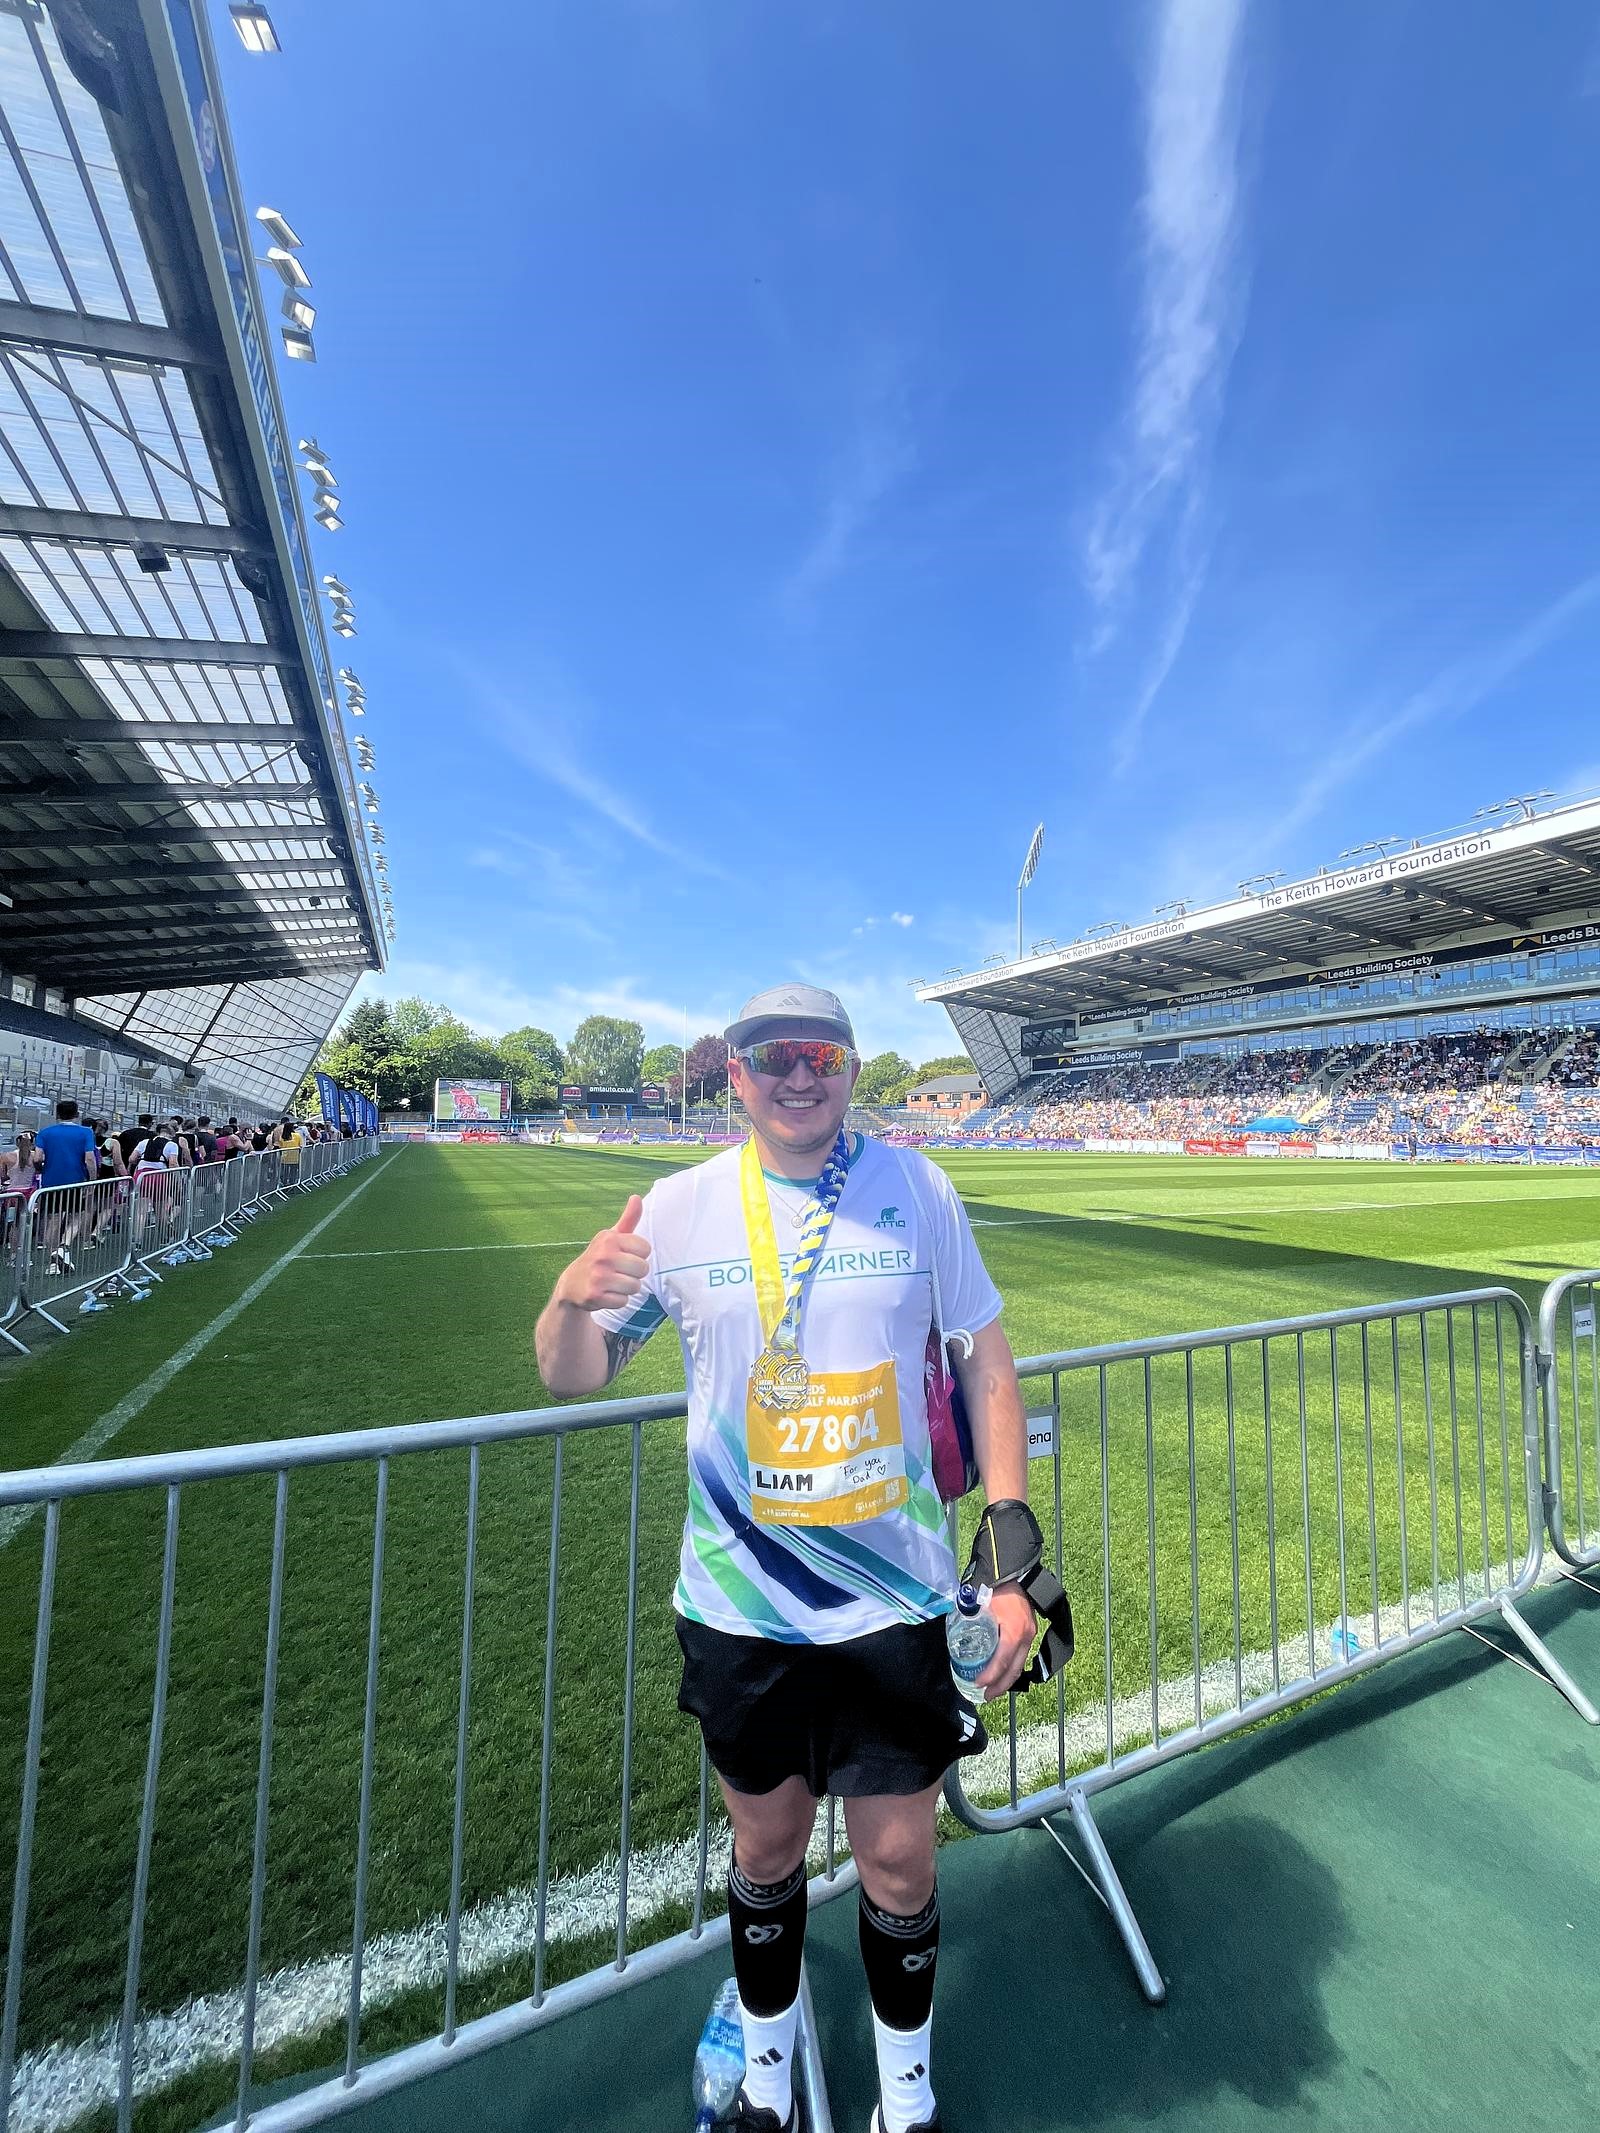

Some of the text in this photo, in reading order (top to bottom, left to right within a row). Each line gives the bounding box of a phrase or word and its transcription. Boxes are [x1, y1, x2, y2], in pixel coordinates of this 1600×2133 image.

[1258, 838, 1491, 909] The Keith Howard Foundation
[1058, 921, 1185, 962] The Keith Howard Foundation
[1541, 928, 1583, 944] Leeds
[1327, 954, 1433, 980] Leeds Building Society
[1180, 985, 1255, 1004] Leeds Building Society
[1091, 1005, 1148, 1020] Leeds Building Society
[1071, 1050, 1143, 1064] Leeds Building Society
[830, 1166, 840, 1184] 2025
[709, 1249, 911, 1288] BOGARNER
[804, 1385, 884, 1407] ALF MARATHON
[805, 1384, 826, 1395] EDS
[777, 1407, 879, 1453] 27804
[1029, 1431, 1052, 1445] ena
[864, 1457, 881, 1471] you
[756, 1470, 813, 1491] LIAM
[852, 1472, 871, 1484] Dad
